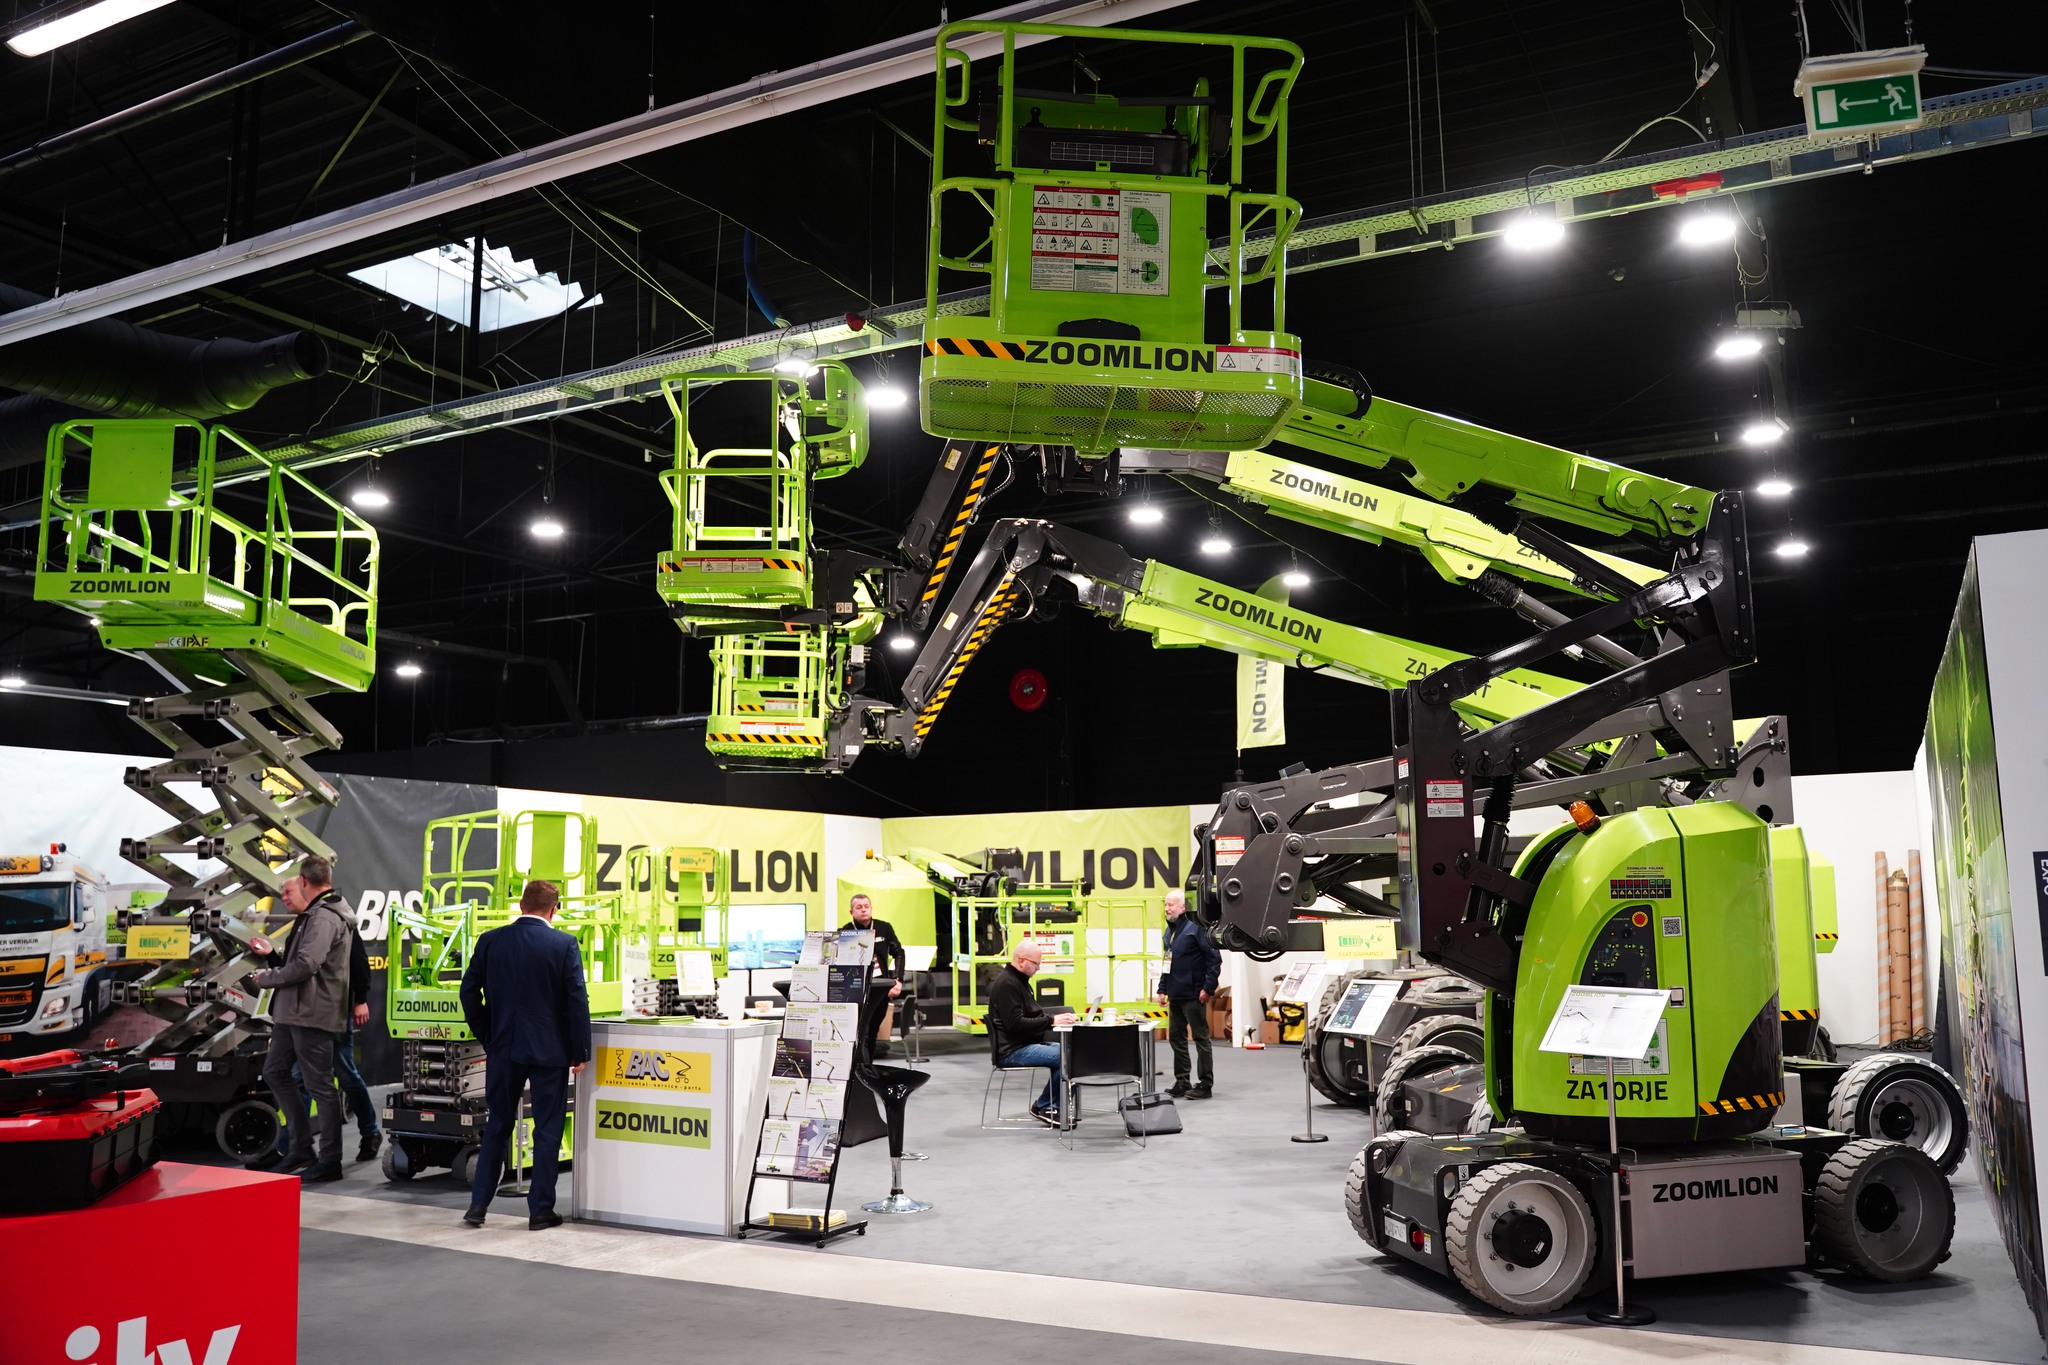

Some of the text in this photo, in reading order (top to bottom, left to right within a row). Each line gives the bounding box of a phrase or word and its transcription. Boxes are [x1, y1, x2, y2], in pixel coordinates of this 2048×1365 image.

[1025, 340, 1214, 374] ZOOMLION
[1270, 470, 1379, 512] ZOOMLION
[69, 580, 171, 593] ZOOMLION
[1194, 588, 1322, 644] ZOOMLION
[183, 634, 209, 647] IPAF
[397, 1001, 458, 1013] ZOOMLION
[430, 1024, 451, 1038] IPAF
[625, 1050, 670, 1082] BAC
[598, 1110, 708, 1138] ZOOMLION
[1653, 1176, 1778, 1203] ZOOMLION
